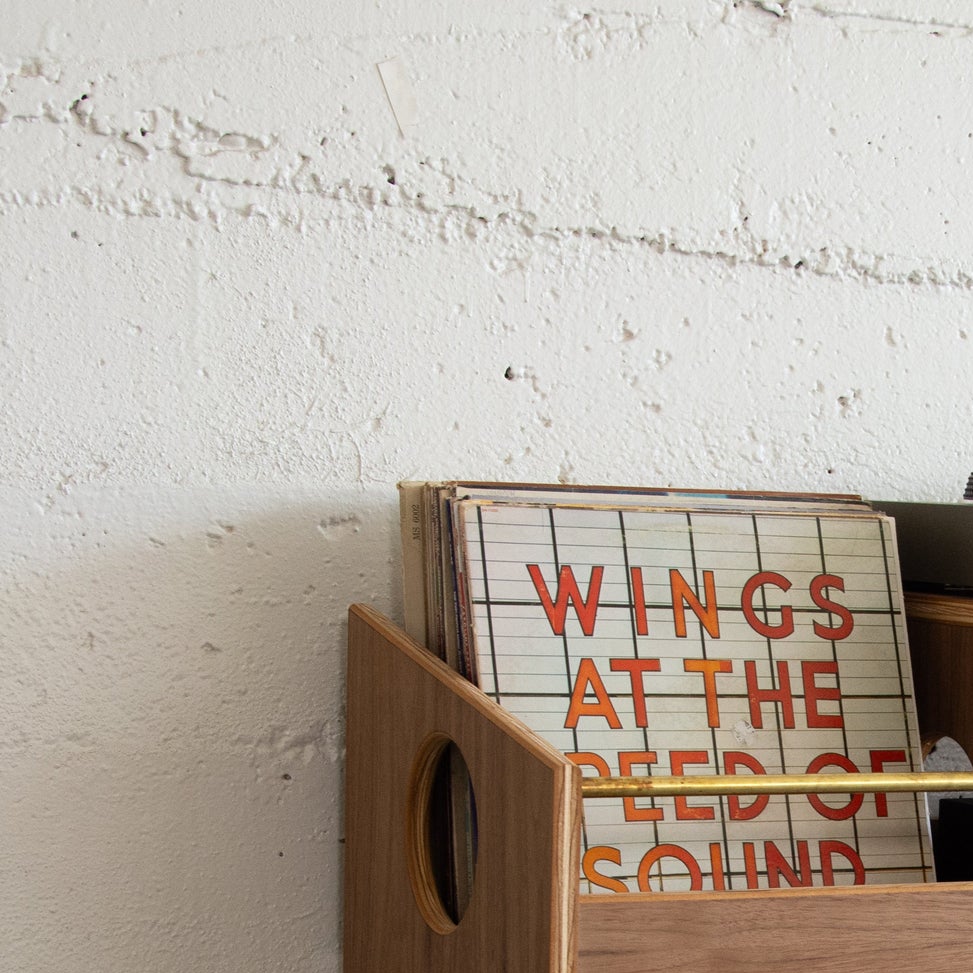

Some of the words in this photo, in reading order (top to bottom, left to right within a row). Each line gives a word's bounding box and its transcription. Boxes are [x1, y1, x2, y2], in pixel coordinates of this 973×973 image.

[525, 563, 855, 641] WINGS
[563, 658, 661, 729] AT
[683, 659, 844, 729] THE
[805, 750, 907, 821] OF
